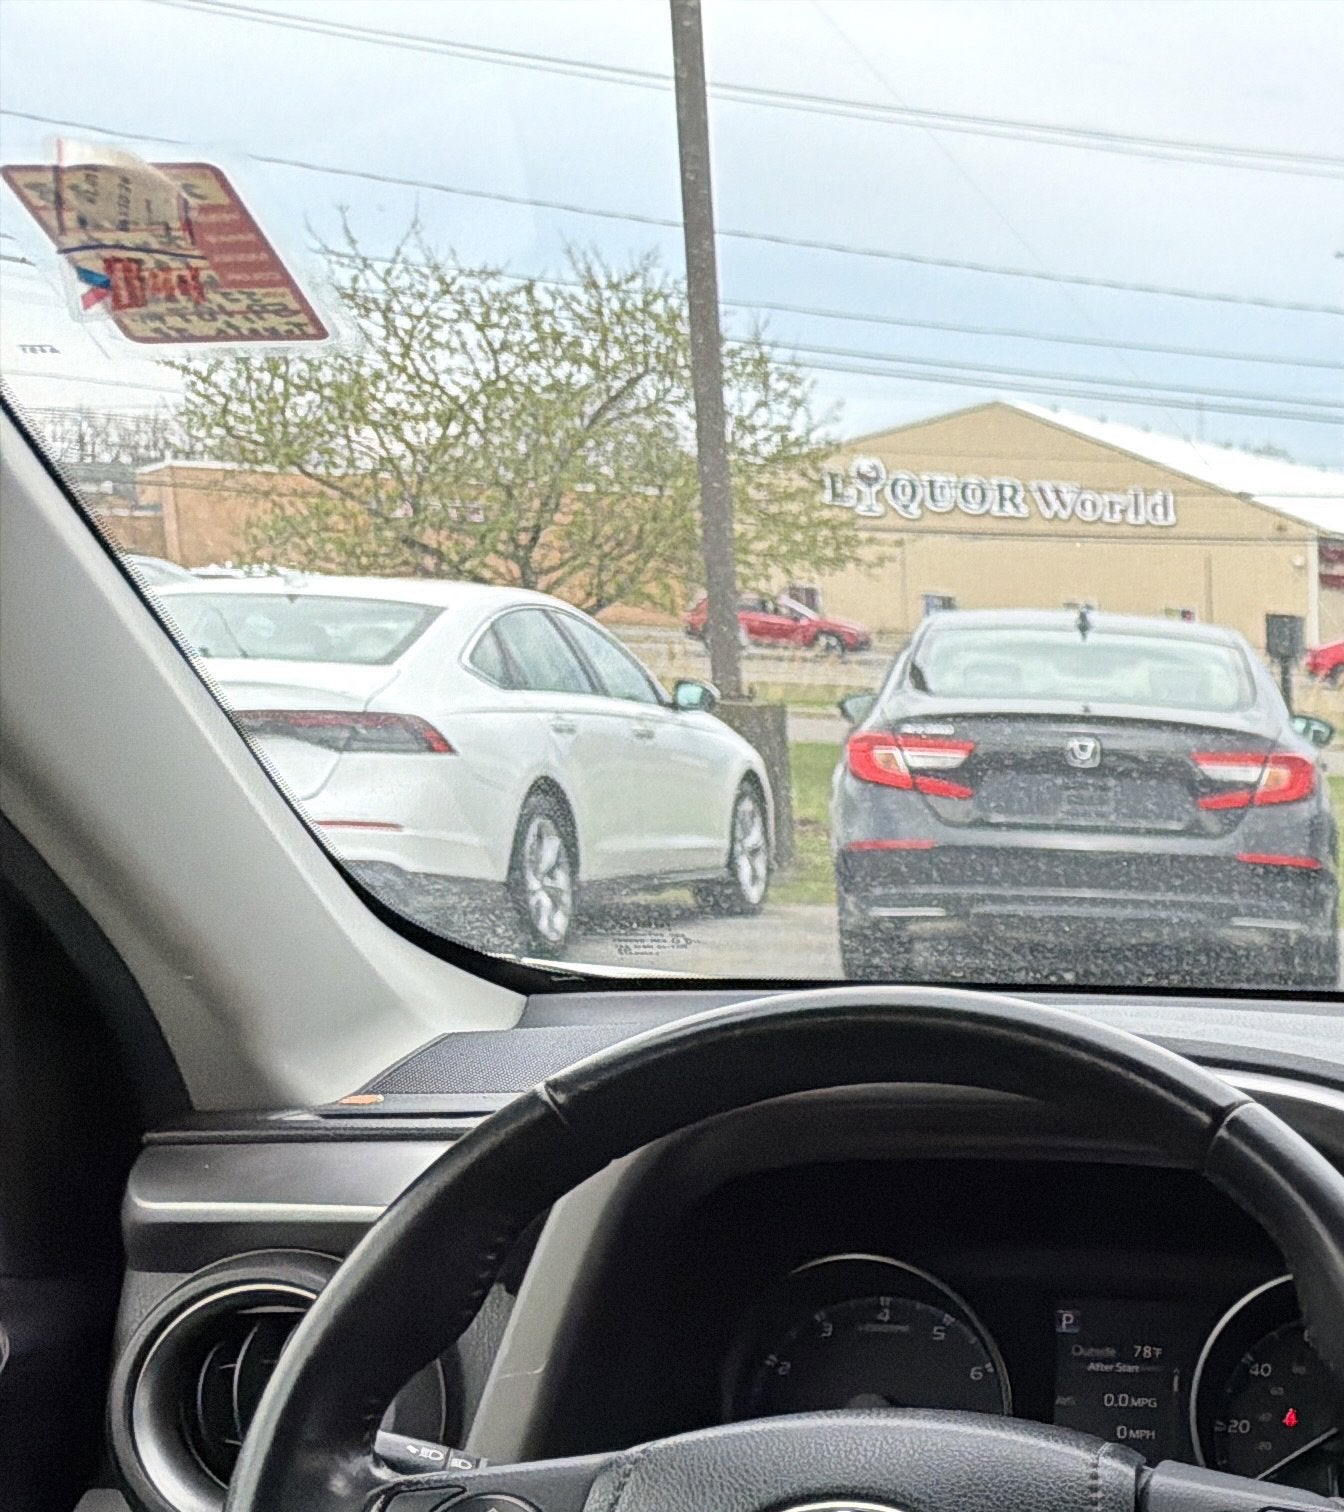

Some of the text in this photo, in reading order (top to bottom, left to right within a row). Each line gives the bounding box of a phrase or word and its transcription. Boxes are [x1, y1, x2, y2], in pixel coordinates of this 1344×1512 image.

[1031, 479, 1177, 527] World
[1062, 1313, 1074, 1330] P
[1250, 1363, 1272, 1378] 40
[1228, 1419, 1250, 1434] 20
